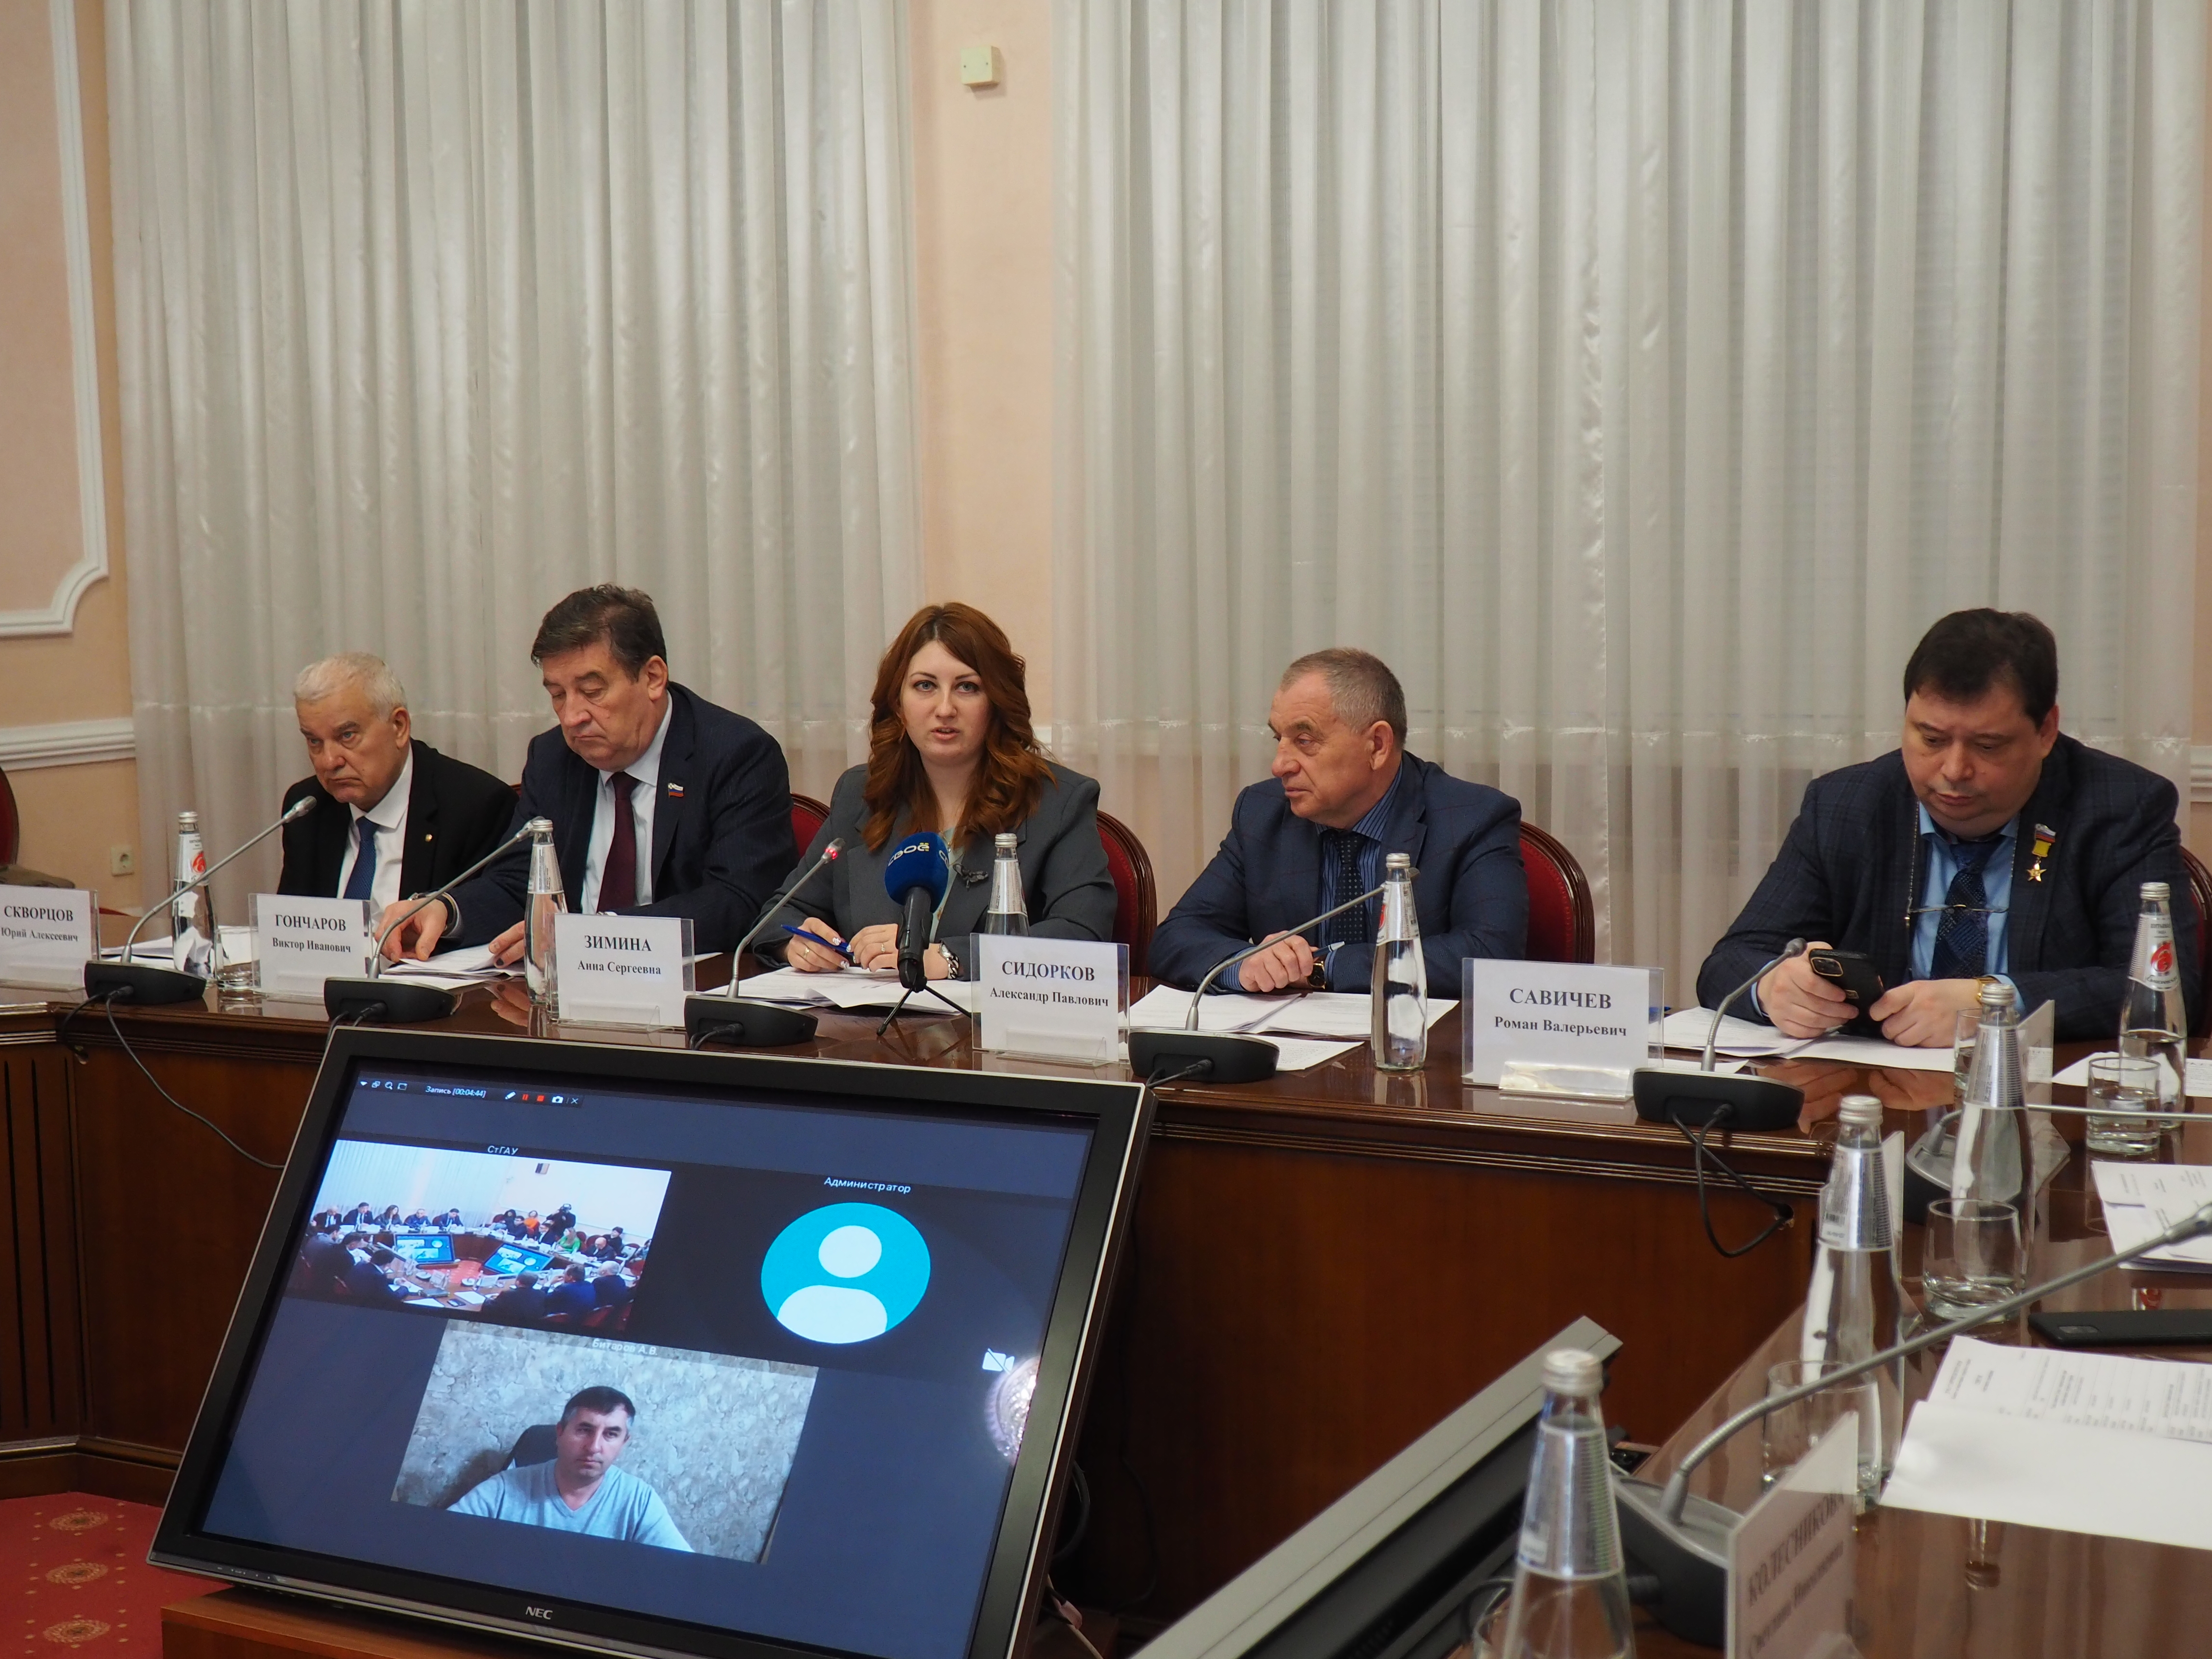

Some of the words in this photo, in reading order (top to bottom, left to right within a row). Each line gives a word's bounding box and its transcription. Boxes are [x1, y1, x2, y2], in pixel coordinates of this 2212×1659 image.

[4, 905, 73, 922] СКВОРЦОВ
[275, 914, 346, 931] ГОНЧАРОВ
[1, 927, 26, 939] Юрий
[29, 929, 78, 942] Алексеевич
[273, 937, 304, 951] Виктор
[307, 940, 351, 953] Иванович
[584, 935, 651, 951] ЗИМИНА
[577, 960, 604, 971] Анна
[607, 962, 661, 975] Сергеевна
[1002, 961, 1095, 982] СИДОРКОВ
[990, 987, 1049, 1004] Александр
[1052, 991, 1109, 1007] Павлович
[1509, 988, 1612, 1009] САВИЧЕВ
[1494, 1016, 1538, 1031] Роман
[1543, 1019, 1627, 1037] Валерьевич
[425, 1085, 451, 1094] Запись
[452, 1088, 486, 1098] [00:04:44]
[487, 1145, 519, 1156] СтГАУ
[824, 1177, 912, 1194] Администратор
[591, 1337, 636, 1353] Битаров
[525, 1606, 553, 1620] NEC
